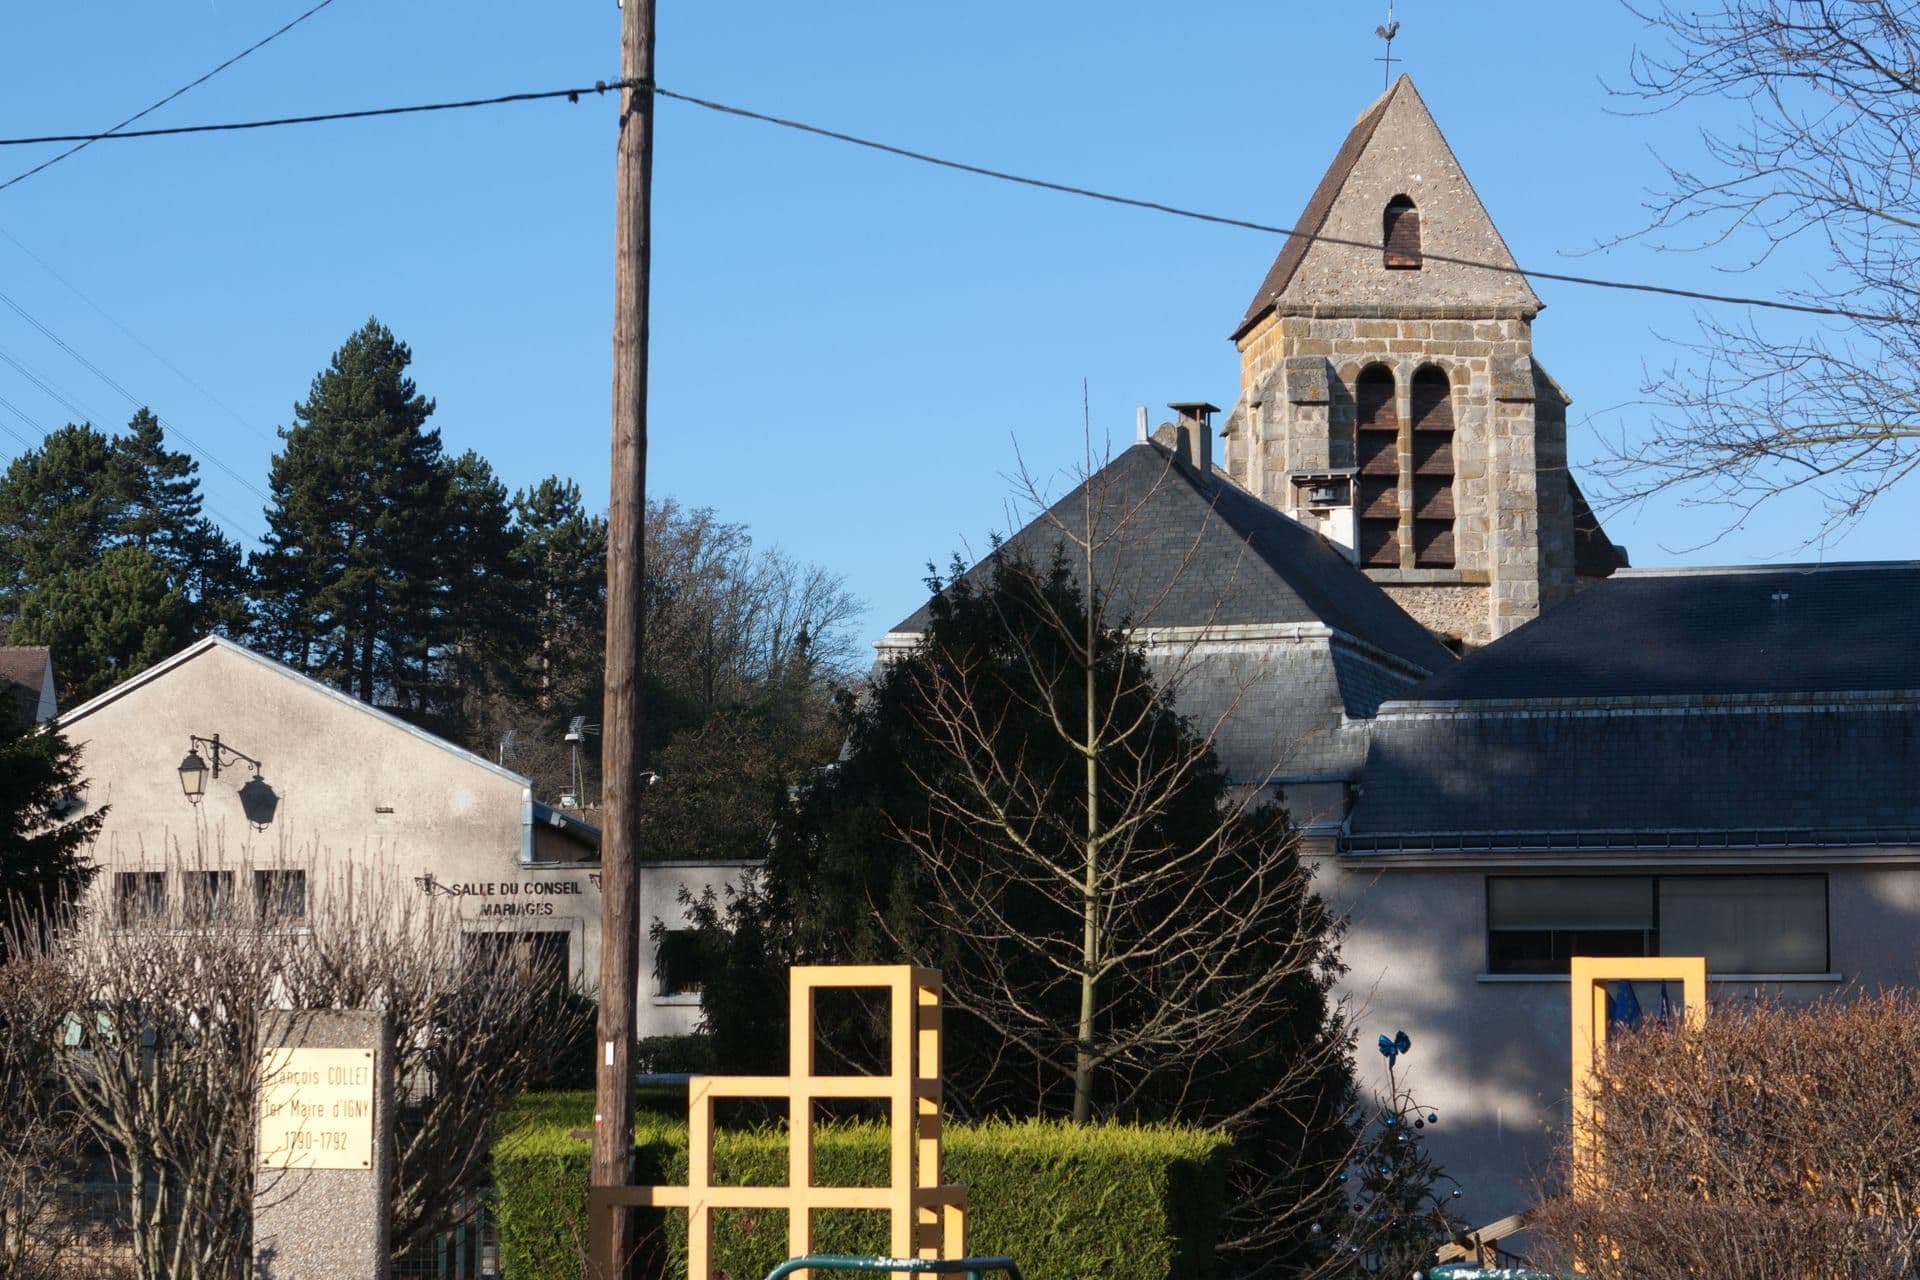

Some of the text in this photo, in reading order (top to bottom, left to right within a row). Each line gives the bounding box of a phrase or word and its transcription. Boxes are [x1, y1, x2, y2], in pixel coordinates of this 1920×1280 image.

[452, 882, 582, 895] SALLE DU CONSEIL
[481, 903, 553, 916] MARIAGES
[267, 1067, 368, 1086] rançois COLLET
[265, 1099, 369, 1118] 1er Maire d'IGNY
[285, 1131, 347, 1150] 1790-1792
